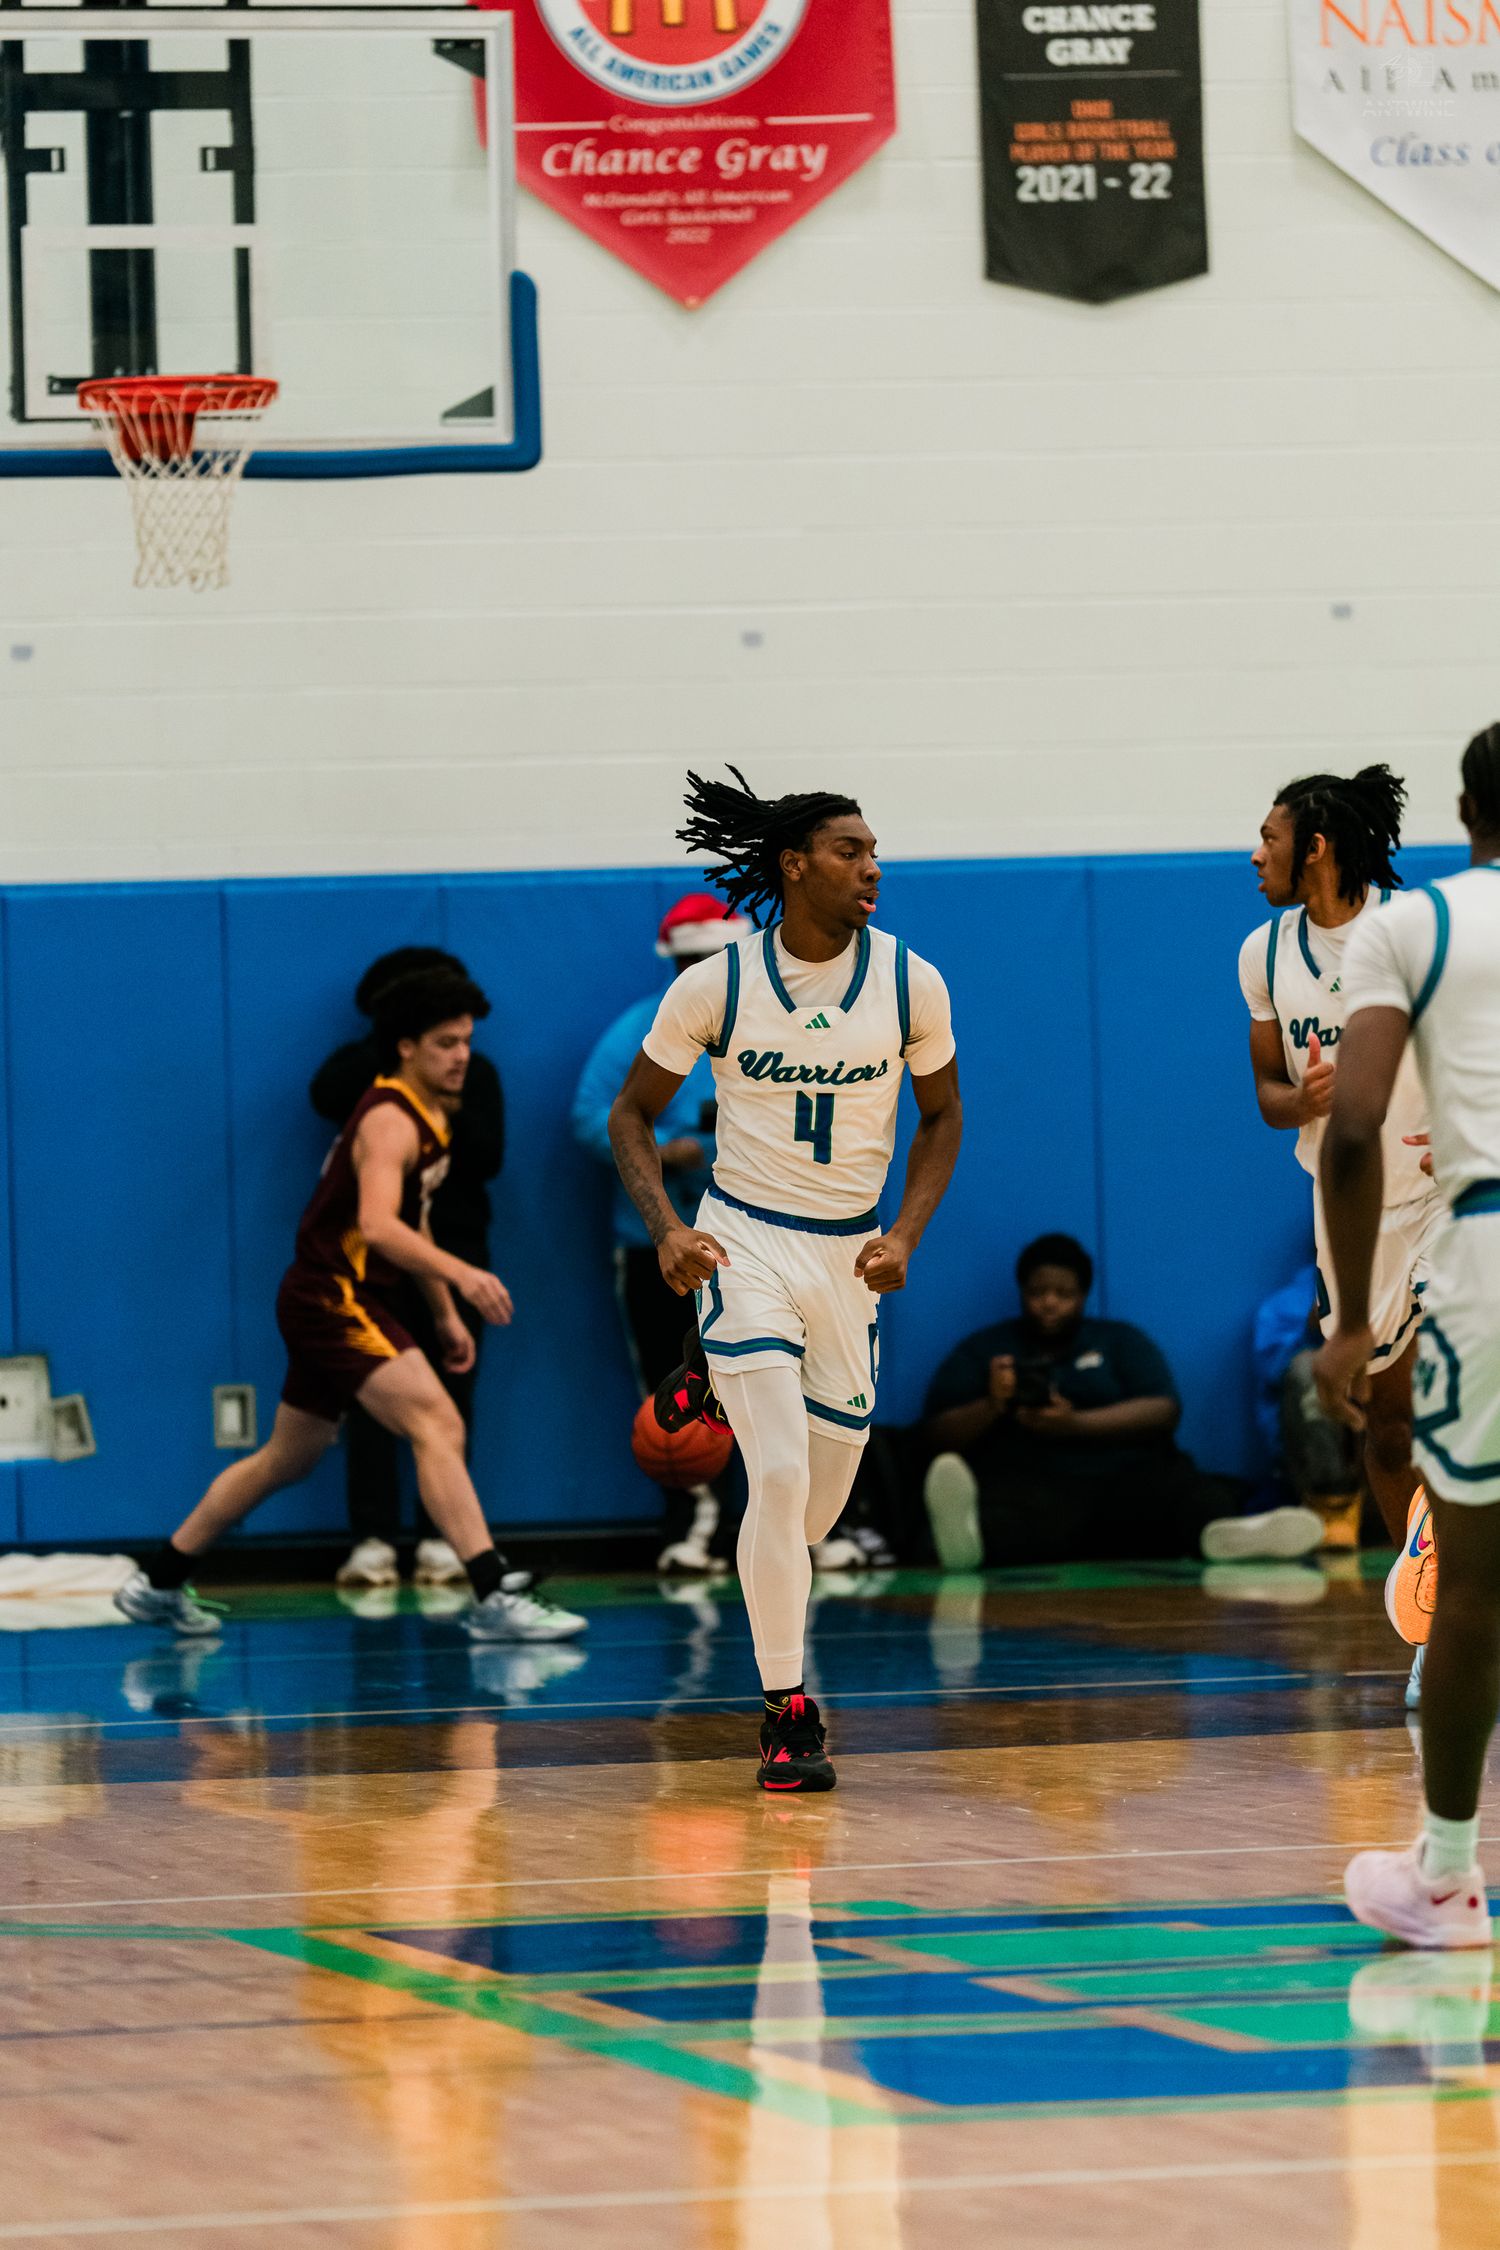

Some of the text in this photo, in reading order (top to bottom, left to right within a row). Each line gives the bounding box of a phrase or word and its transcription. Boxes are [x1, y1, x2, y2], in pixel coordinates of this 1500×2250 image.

[1022, 4, 1157, 34] CHANCE
[569, 20, 782, 91] ALL AMERICAN GAMES
[1045, 37, 1134, 66] GRAY
[541, 138, 829, 181] Chance Gray
[1369, 132, 1471, 167] Class
[1015, 164, 1097, 202] 2021
[1128, 162, 1173, 200] 22
[737, 1049, 888, 1085] Warriors
[794, 1090, 835, 1165] 4
